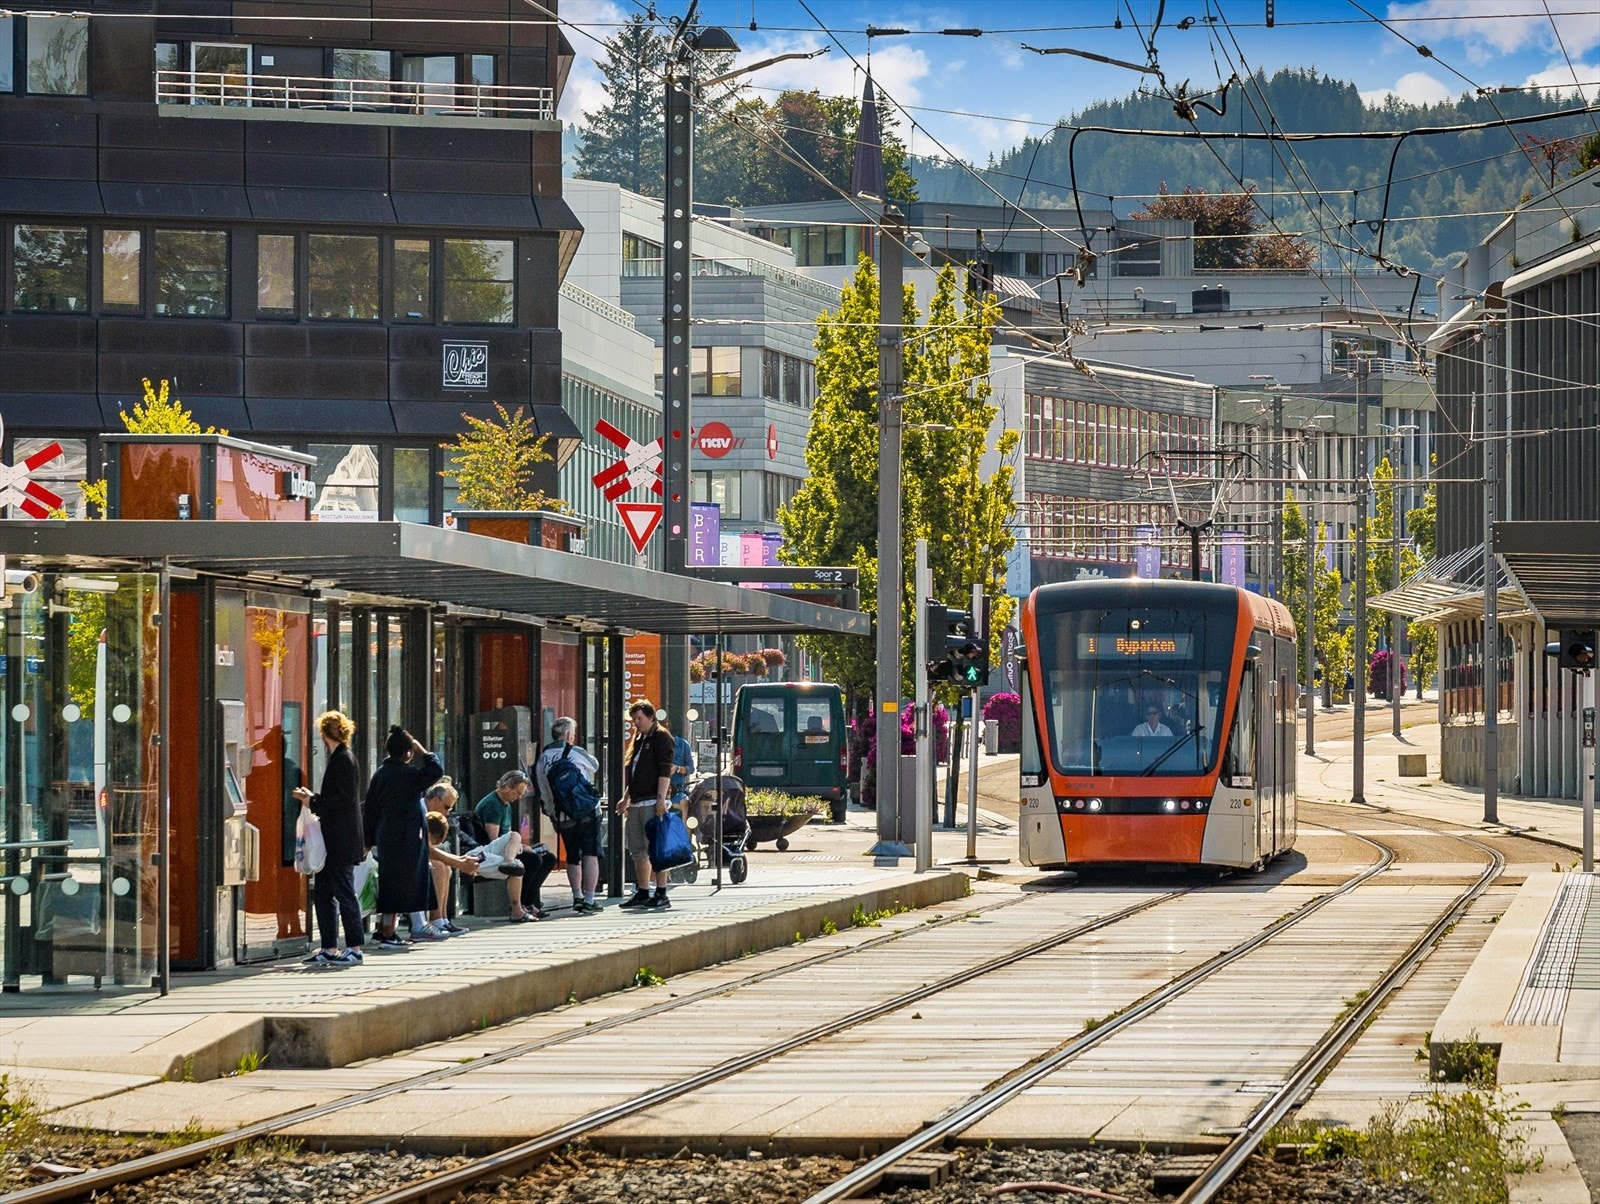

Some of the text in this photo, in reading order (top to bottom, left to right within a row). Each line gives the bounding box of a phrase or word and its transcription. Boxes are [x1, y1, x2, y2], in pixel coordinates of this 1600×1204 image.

[446, 347, 486, 383] Chic
[700, 438, 731, 449] nav
[814, 570, 833, 579] Spor
[834, 571, 842, 581] 2
[1088, 638, 1175, 655] 1 Byparken
[1029, 798, 1040, 809] 220
[1230, 798, 1242, 809] 220
